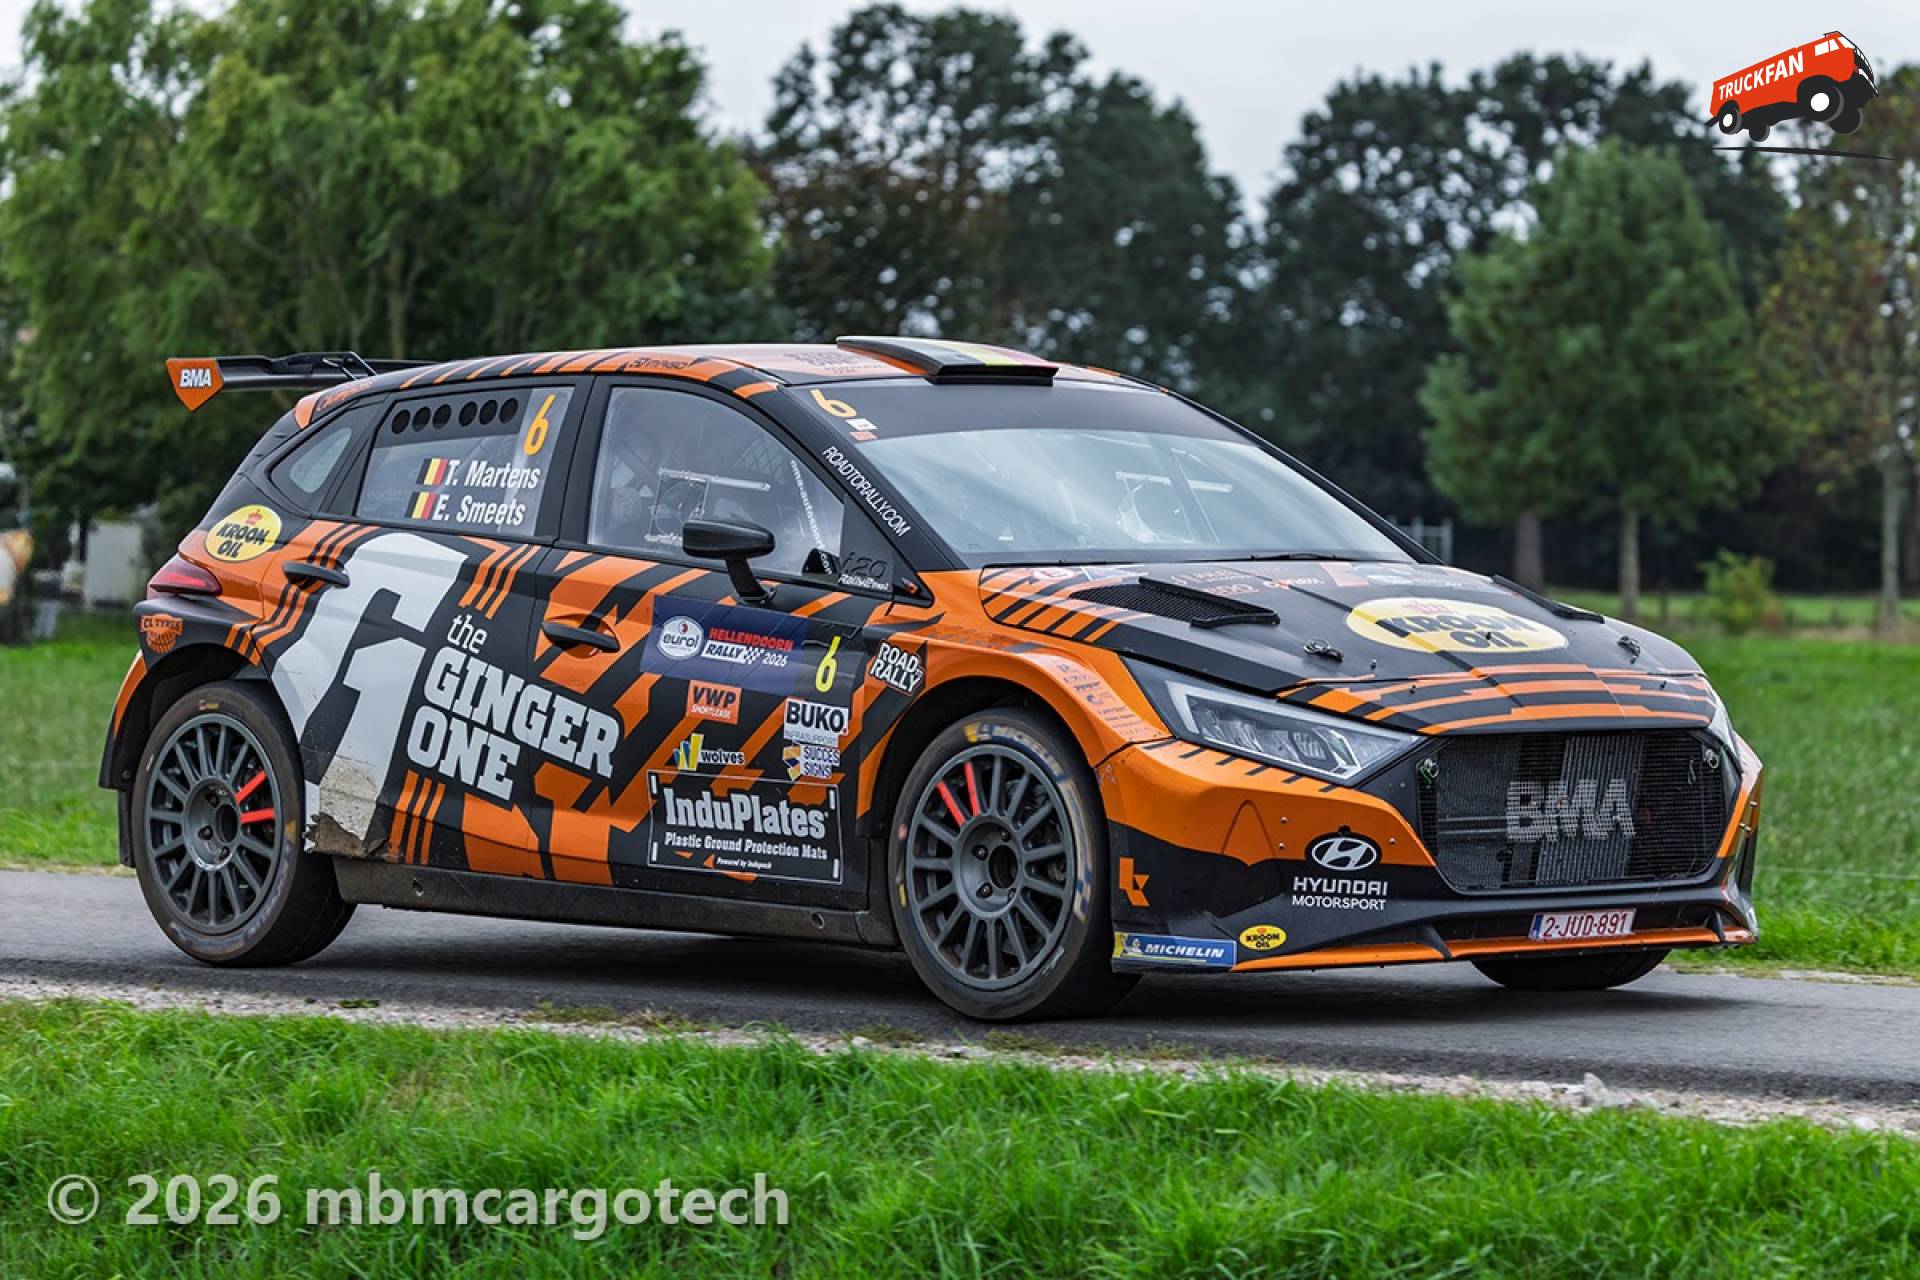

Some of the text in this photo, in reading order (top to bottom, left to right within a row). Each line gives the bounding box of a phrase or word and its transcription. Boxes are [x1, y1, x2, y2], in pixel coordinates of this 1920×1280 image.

[180, 368, 212, 388] BMA
[811, 388, 857, 417] 6
[523, 394, 556, 456] 6
[445, 459, 541, 489] T. Martens
[822, 446, 911, 536] ROADTORALLY.COM
[432, 493, 450, 521] E.
[456, 495, 525, 526] Smeets
[216, 523, 270, 546] KROON
[217, 540, 244, 559] OIL
[447, 614, 488, 654] the
[1376, 615, 1539, 638] KROON
[663, 633, 700, 649] eurol
[709, 628, 793, 651] HELLENDOORN
[1450, 631, 1528, 648] OIL
[706, 643, 788, 667] RALLY 2026
[815, 635, 841, 694] 6
[878, 642, 919, 672] ROAD
[870, 659, 923, 692] RALLY
[693, 686, 736, 708] VWP
[423, 647, 620, 778] GINGER
[407, 705, 520, 800] ONE
[701, 750, 744, 764] wolves
[803, 746, 840, 764] SUCCES
[803, 762, 832, 778] SIGNS
[663, 788, 826, 839] InduPlates
[1506, 779, 1637, 843] BMA
[664, 832, 828, 860] Plastic Ground Protection Mats
[1293, 877, 1388, 896] HYUNDAI
[1292, 895, 1386, 911] MOTORSPORT
[1543, 913, 1628, 937] 2-JUD-891
[1246, 933, 1281, 942] KROON
[1145, 943, 1224, 958] MICHELIN
